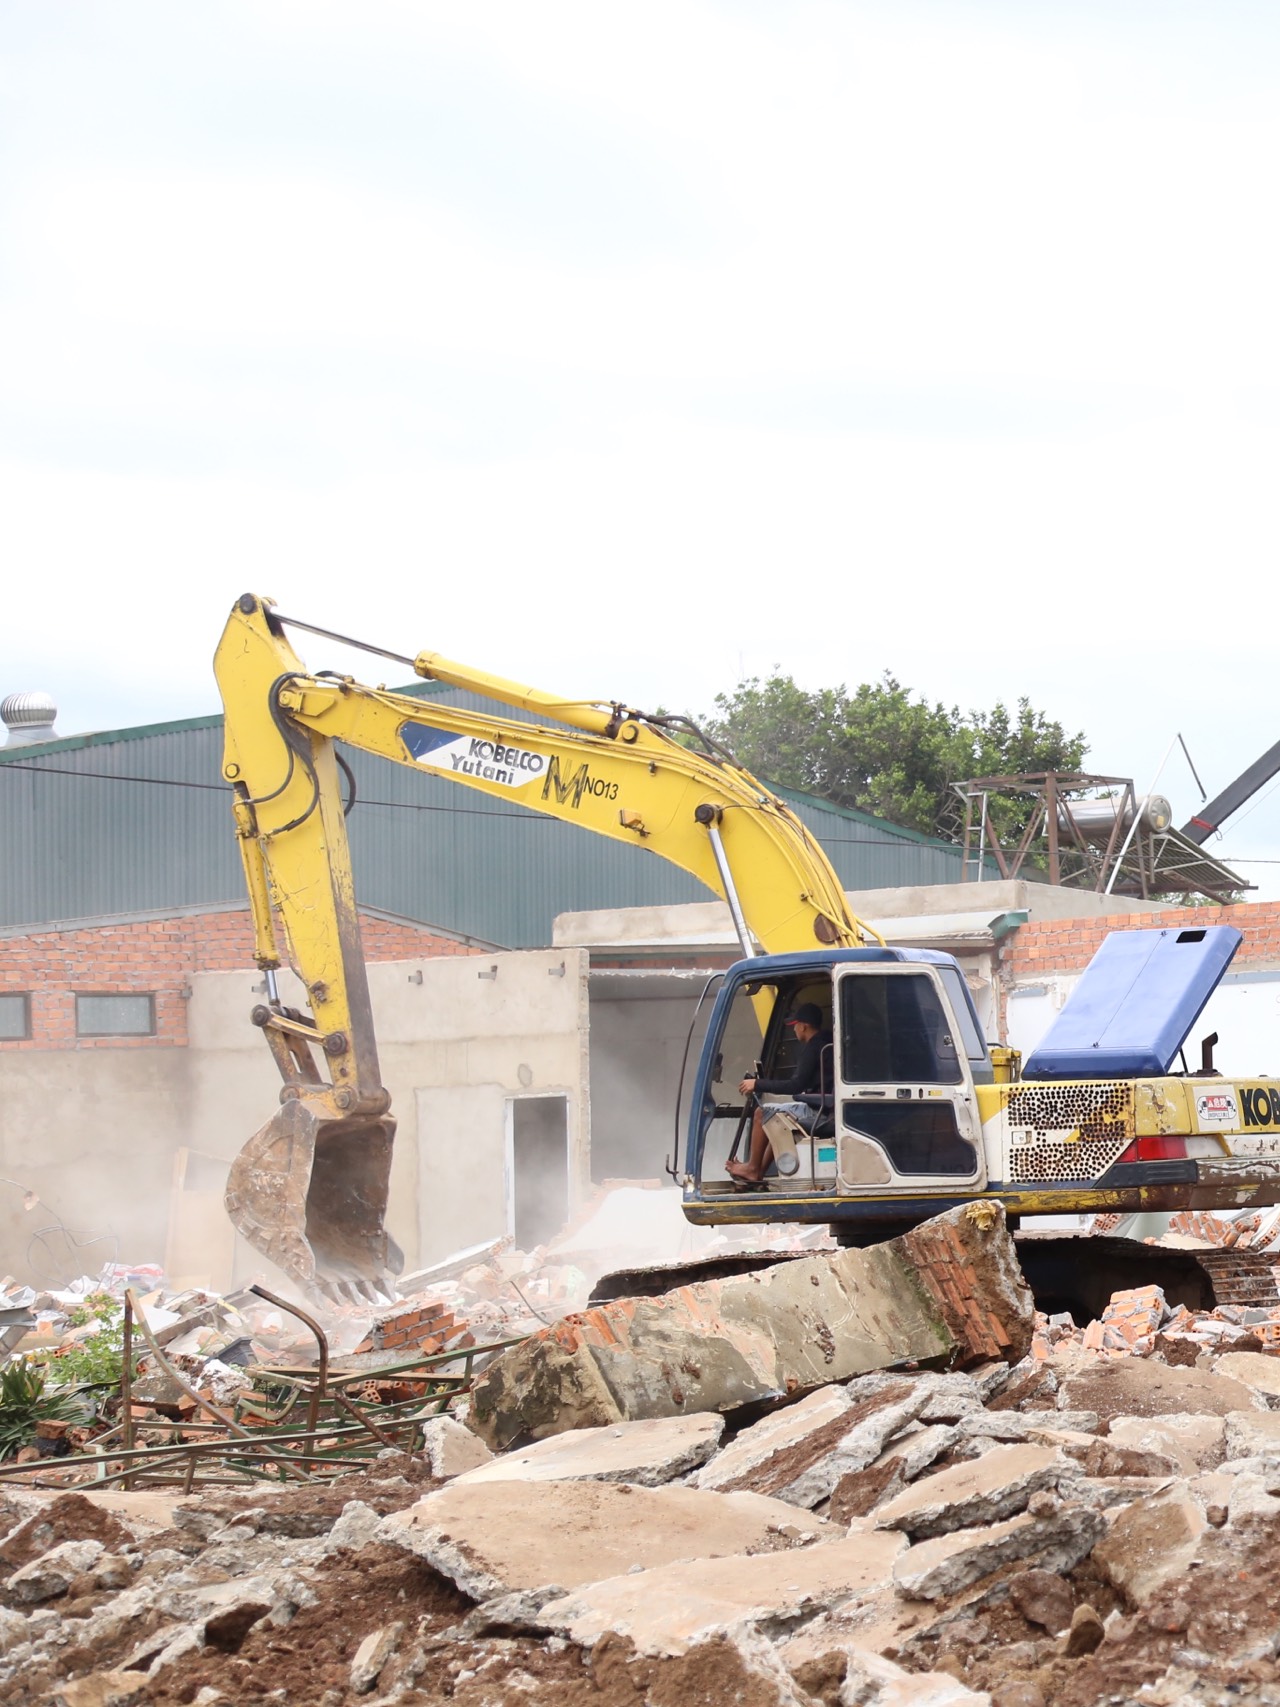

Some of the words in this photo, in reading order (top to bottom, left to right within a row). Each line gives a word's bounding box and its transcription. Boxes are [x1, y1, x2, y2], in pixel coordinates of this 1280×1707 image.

[450, 753, 515, 784] Yutani
[468, 738, 544, 772] KOBELCO
[583, 775, 620, 801] NO13
